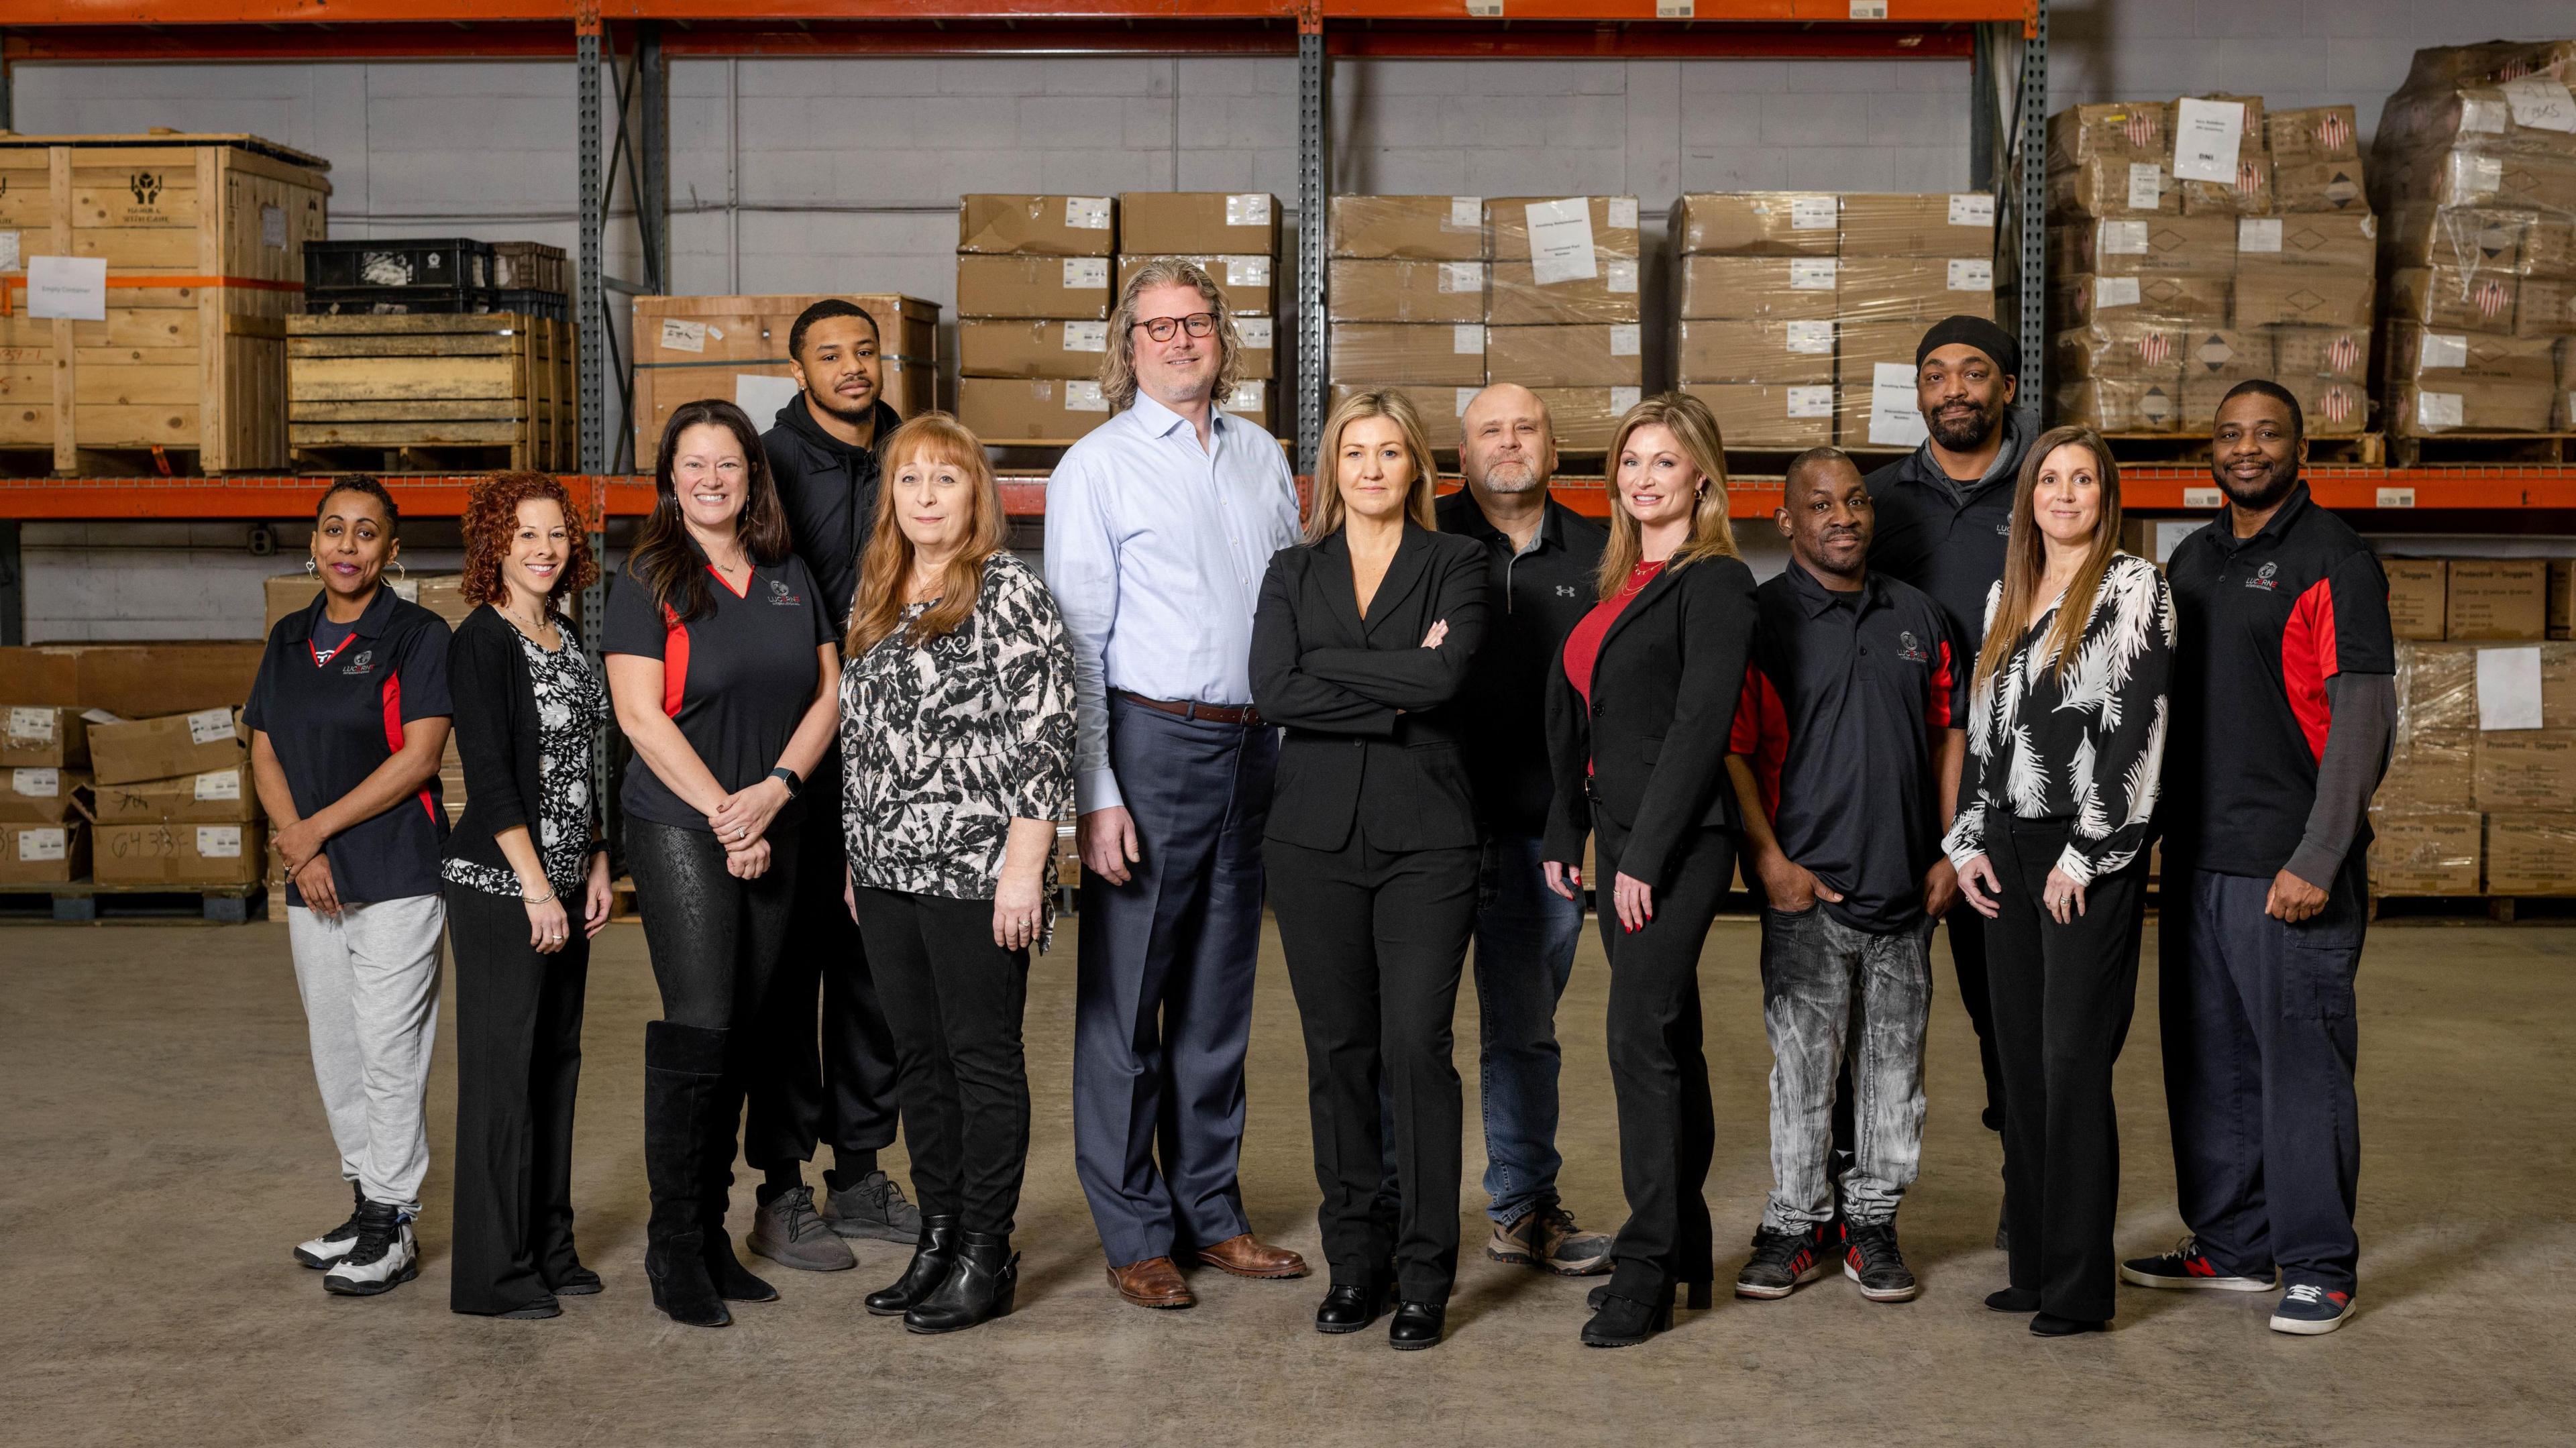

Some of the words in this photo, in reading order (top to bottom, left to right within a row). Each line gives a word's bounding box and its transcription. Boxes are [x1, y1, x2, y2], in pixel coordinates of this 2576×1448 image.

[2199, 152, 2214, 161] DNI
[2400, 571, 2432, 580] Goggles
[2502, 571, 2534, 579] Goggles
[2246, 577, 2278, 588] LUCERNE
[2245, 583, 2272, 592] INTERNATIONAL
[342, 664, 376, 673] LUCERNE
[2535, 742, 2567, 750] Goggles
[2433, 825, 2466, 834] Goggles
